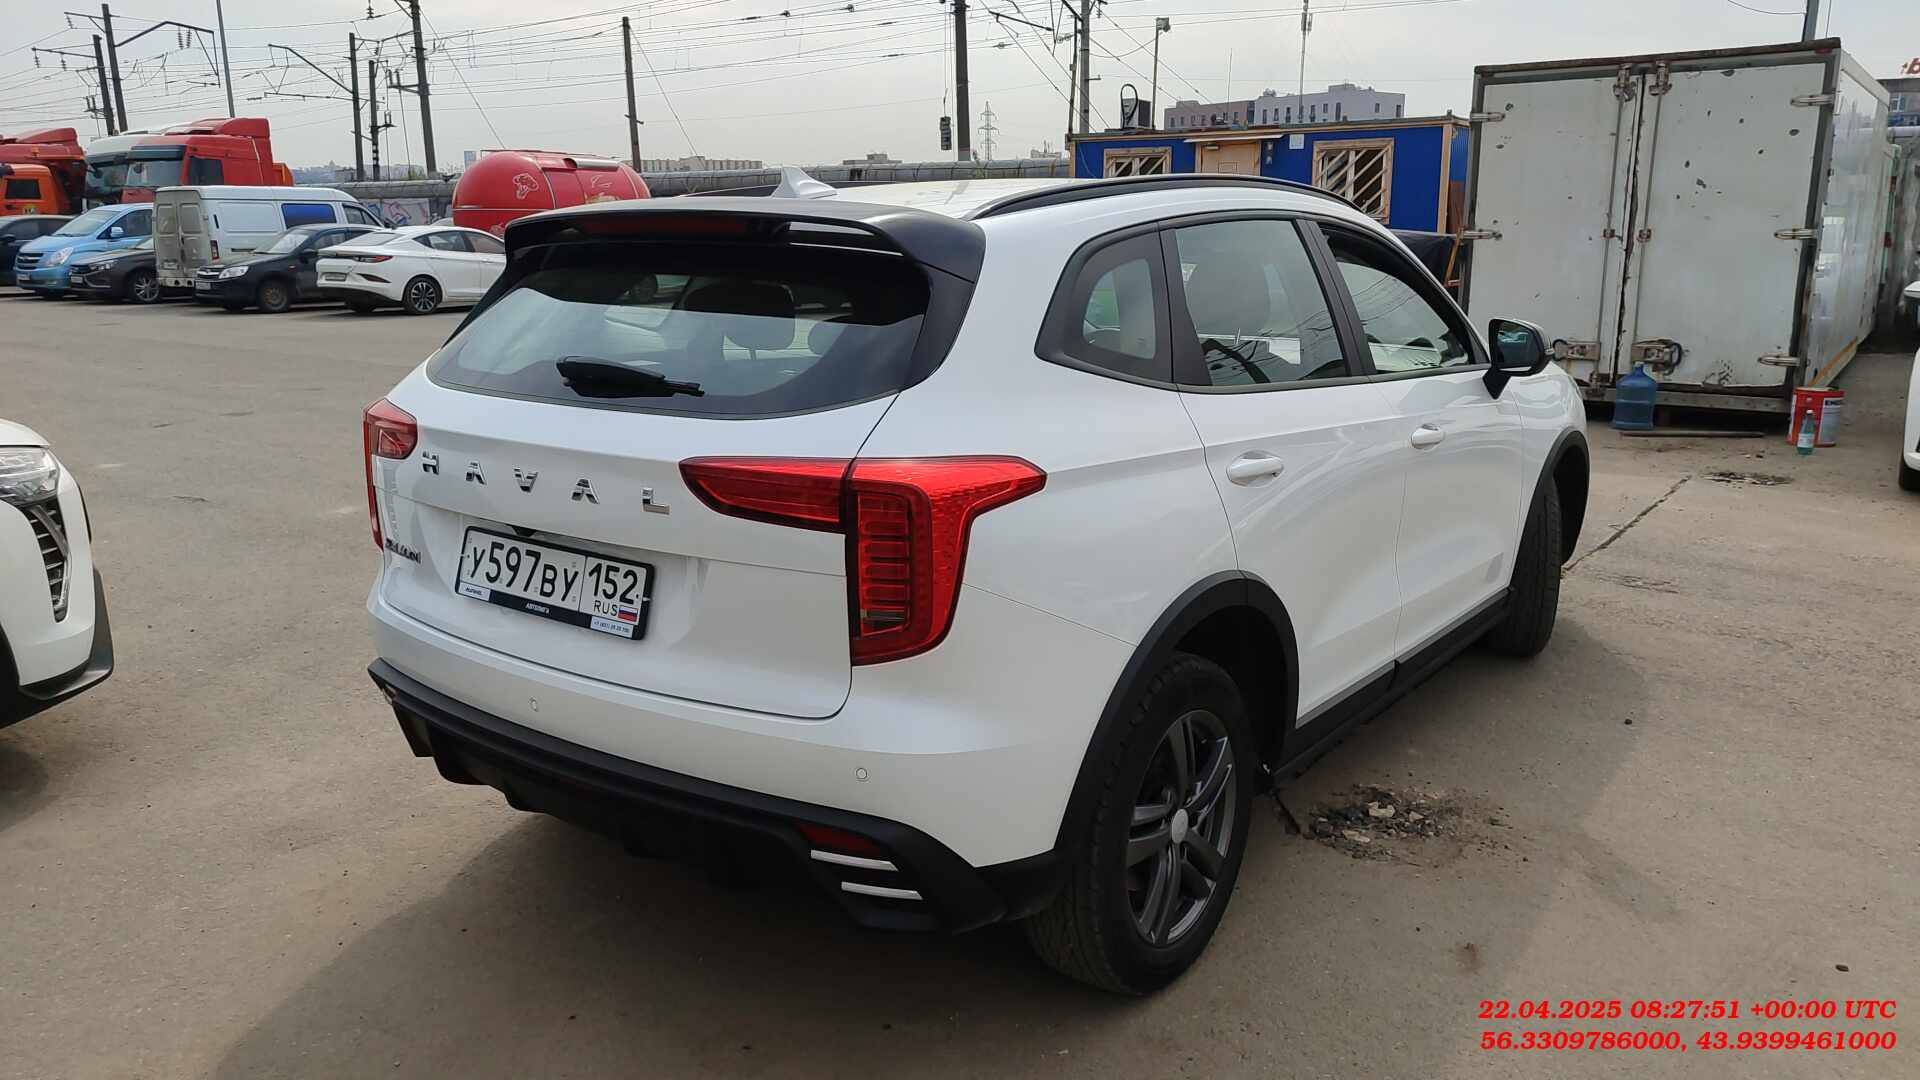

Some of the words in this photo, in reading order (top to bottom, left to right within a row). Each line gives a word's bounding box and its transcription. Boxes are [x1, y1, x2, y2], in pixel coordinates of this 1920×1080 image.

[421, 451, 671, 515] HAVAL
[588, 563, 638, 605] 152
[593, 600, 618, 616] RUS
